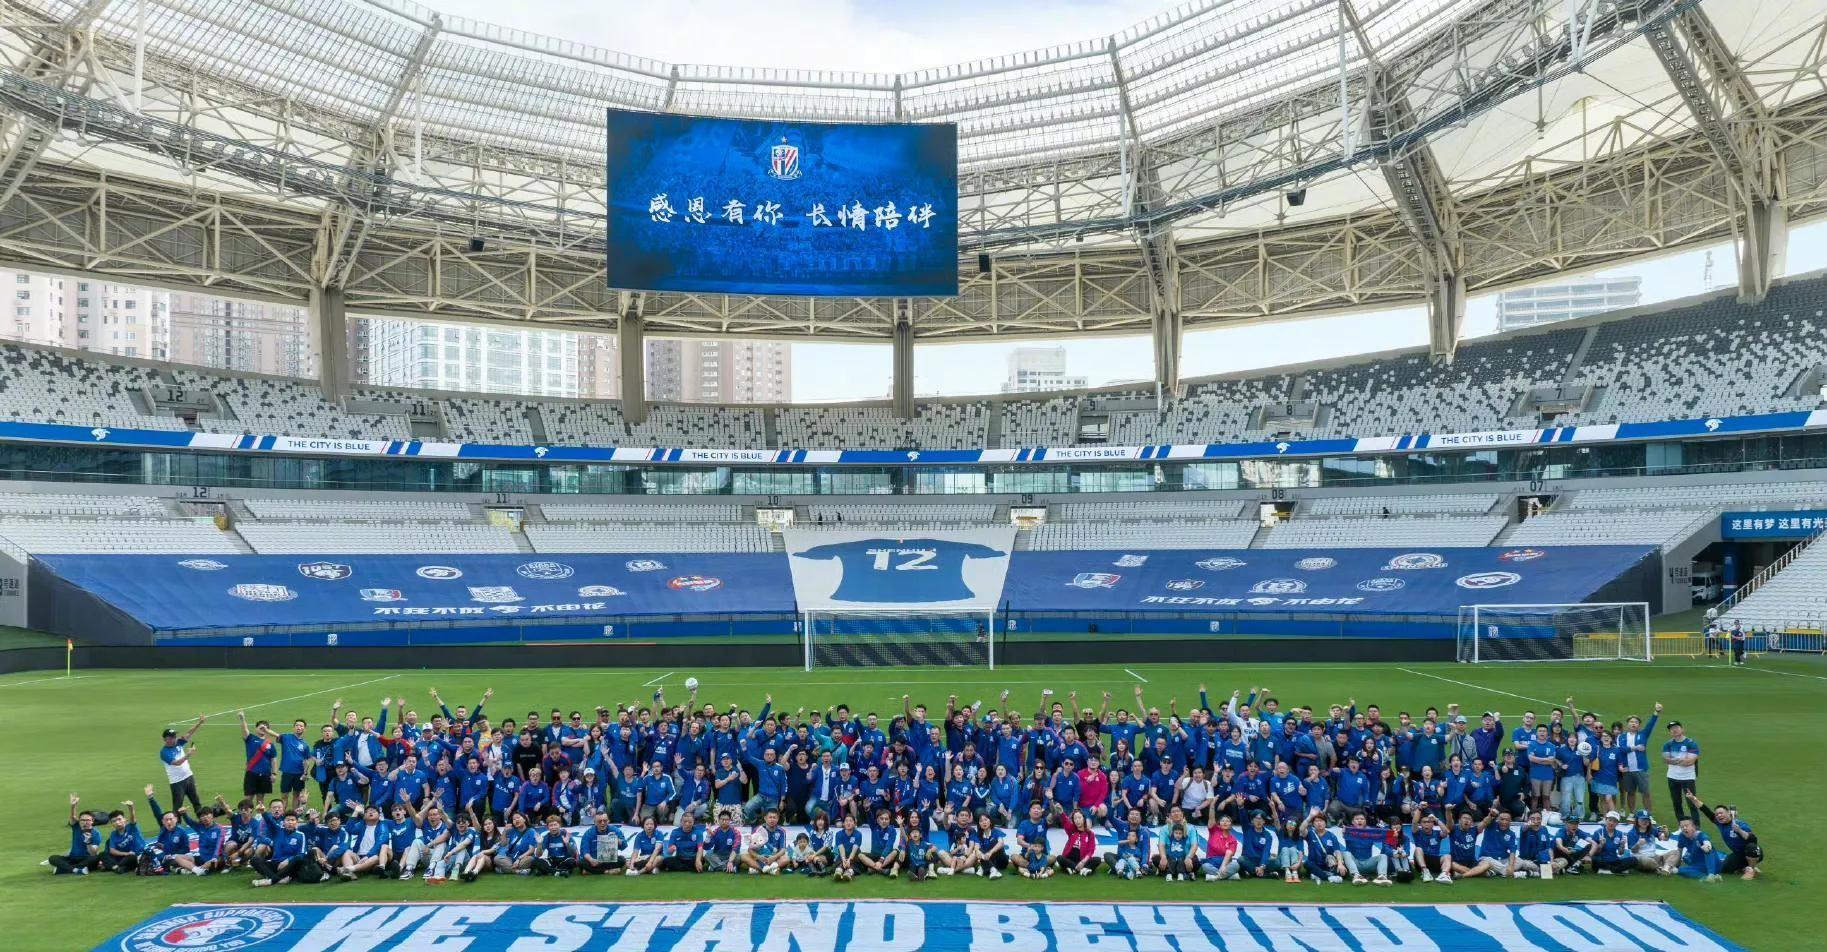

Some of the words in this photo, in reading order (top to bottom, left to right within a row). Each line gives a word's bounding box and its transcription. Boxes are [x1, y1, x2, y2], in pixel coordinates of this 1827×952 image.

[648, 193, 784, 226] 感恩有你
[805, 200, 937, 231] 长情陪伴
[167, 389, 184, 402] 12
[411, 403, 426, 416] 11
[1441, 437, 1460, 445] THE
[1462, 435, 1483, 444] CITY
[1485, 434, 1494, 442] IS
[1496, 433, 1523, 442] BLUE
[287, 440, 307, 449] THE
[309, 441, 332, 450] CITY
[333, 442, 343, 450] IS
[345, 442, 371, 451] BLUE
[740, 452, 763, 460] BLUE
[1056, 450, 1072, 458] THE
[1094, 449, 1102, 457] IS
[1104, 449, 1126, 457] BLUE
[193, 486, 208, 498] 12
[1529, 480, 1544, 492] 07
[496, 493, 508, 504] 11
[767, 495, 779, 505] 10
[1021, 494, 1034, 504] 09
[1271, 489, 1284, 500] 08
[1731, 518, 1776, 530] 这里有梦
[865, 549, 939, 571] 12
[286, 905, 514, 952] WE
[506, 903, 926, 952] STAND
[966, 903, 1441, 952] BEHIND
[1433, 903, 1730, 952] YOU
